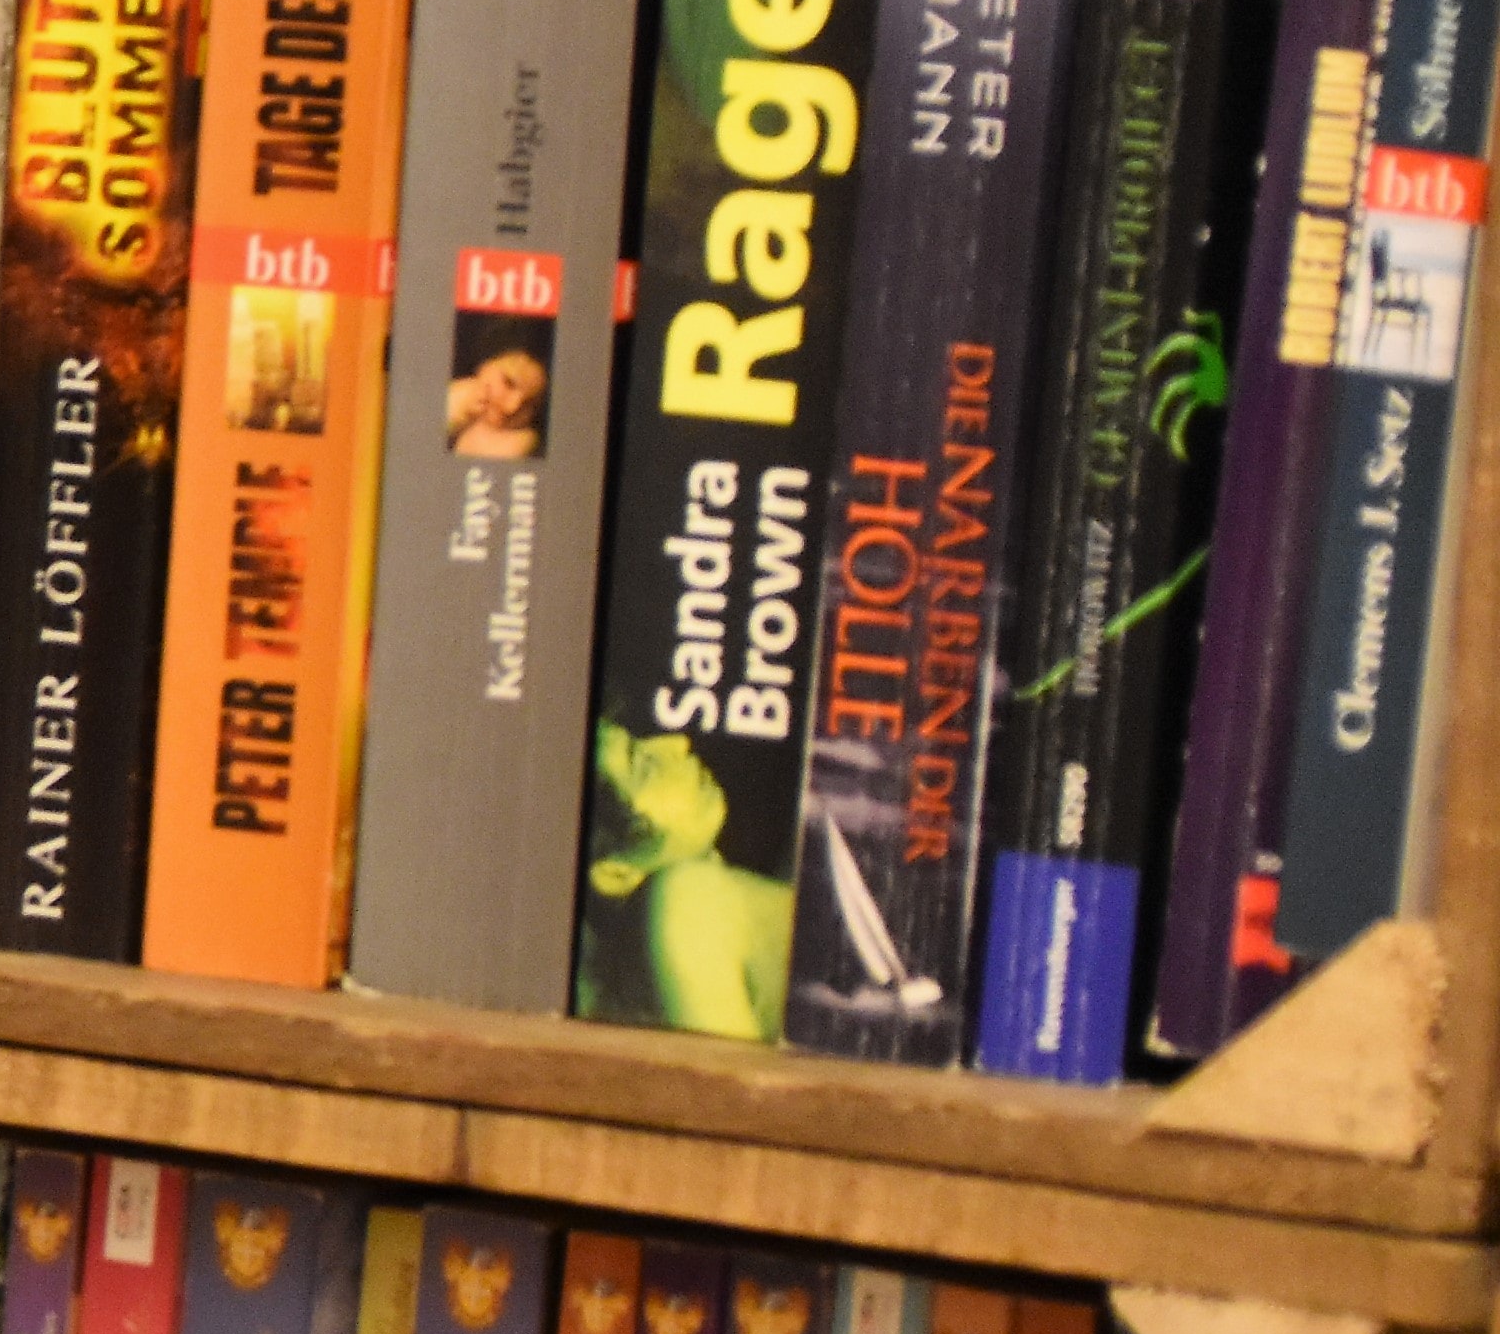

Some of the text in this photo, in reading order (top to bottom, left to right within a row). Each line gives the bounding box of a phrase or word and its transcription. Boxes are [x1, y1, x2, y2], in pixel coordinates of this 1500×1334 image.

[255, 65, 345, 196] TAGE
[497, 61, 544, 234] Habgier
[468, 267, 553, 307] btb
[451, 469, 501, 562] Faye
[486, 475, 537, 701] Kellerman
[657, 460, 737, 732] Sandra
[728, 466, 810, 741] Brown
[905, 341, 995, 864] DIE NARBEN DER
[22, 355, 101, 920] RAINER LÖFFLER
